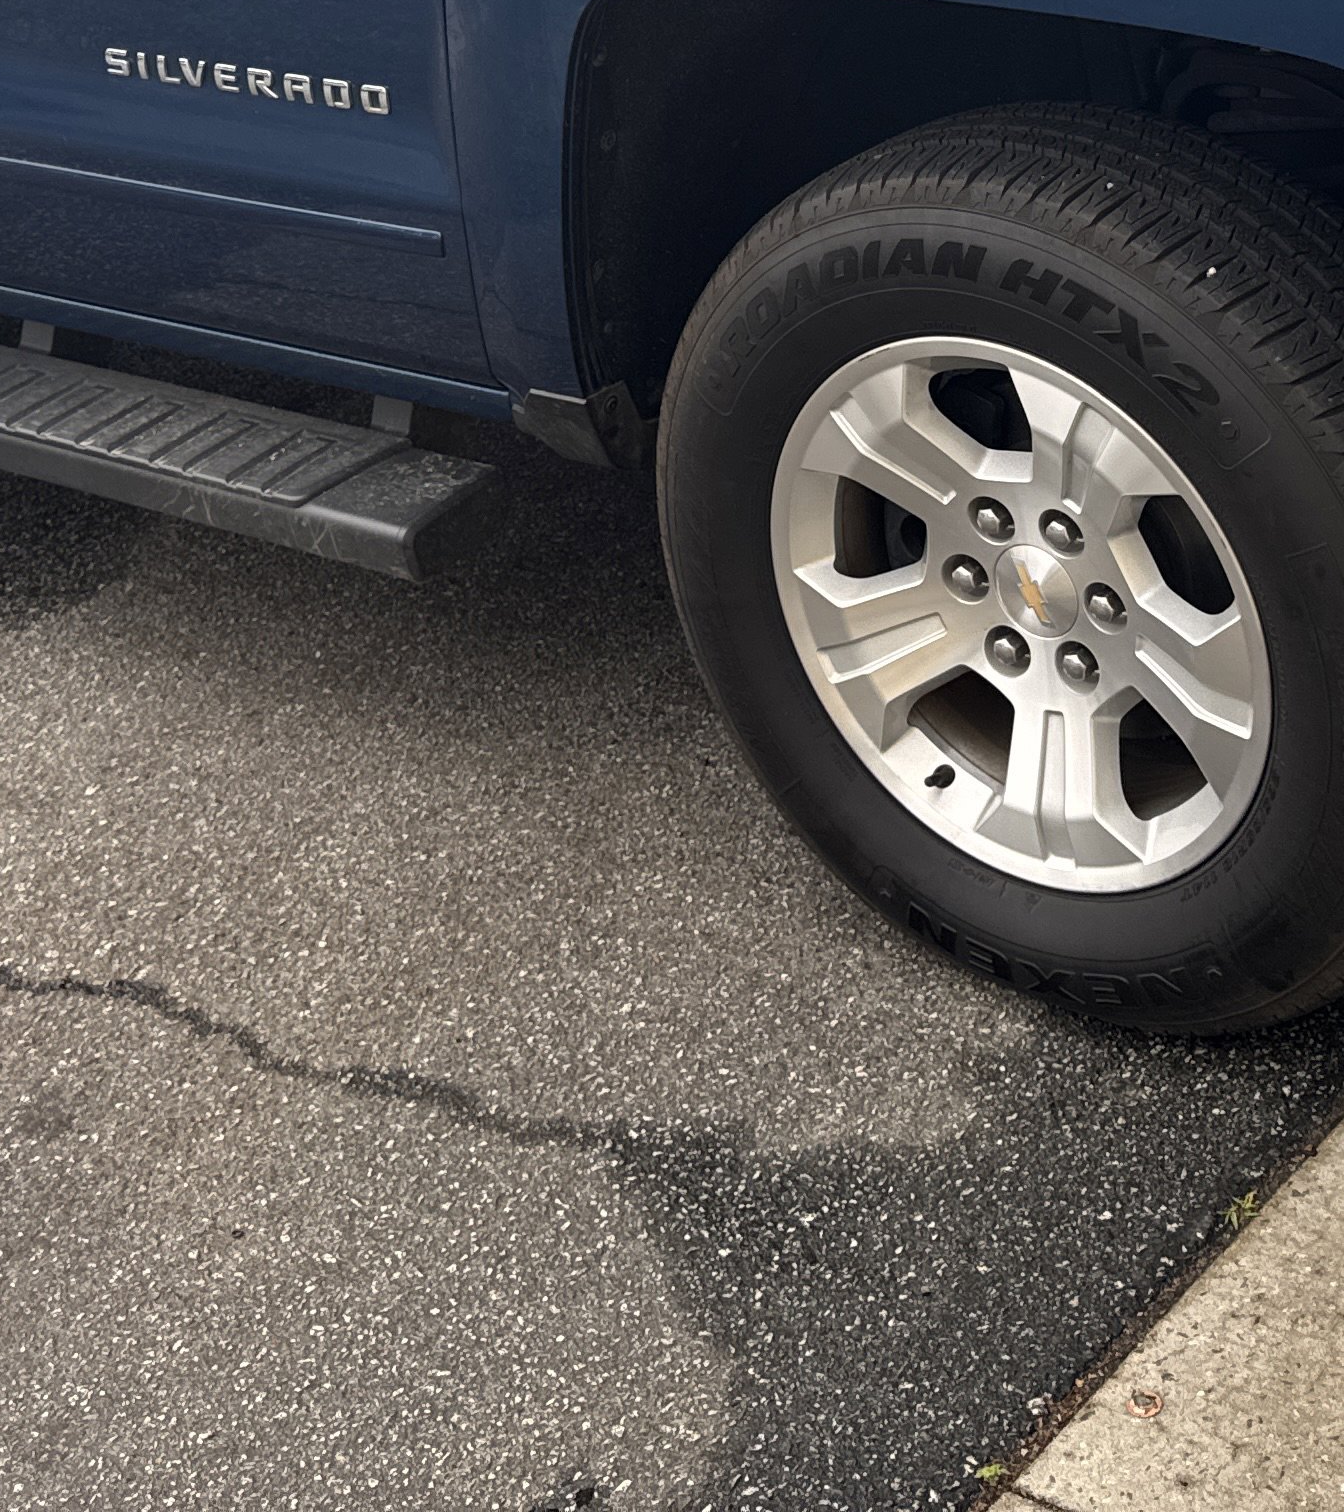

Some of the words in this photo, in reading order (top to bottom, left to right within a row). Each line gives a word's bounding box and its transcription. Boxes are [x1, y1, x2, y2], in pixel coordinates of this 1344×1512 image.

[104, 46, 393, 117] SILVERADO
[718, 236, 988, 383] ROADIAN
[999, 255, 1222, 416] HTX2
